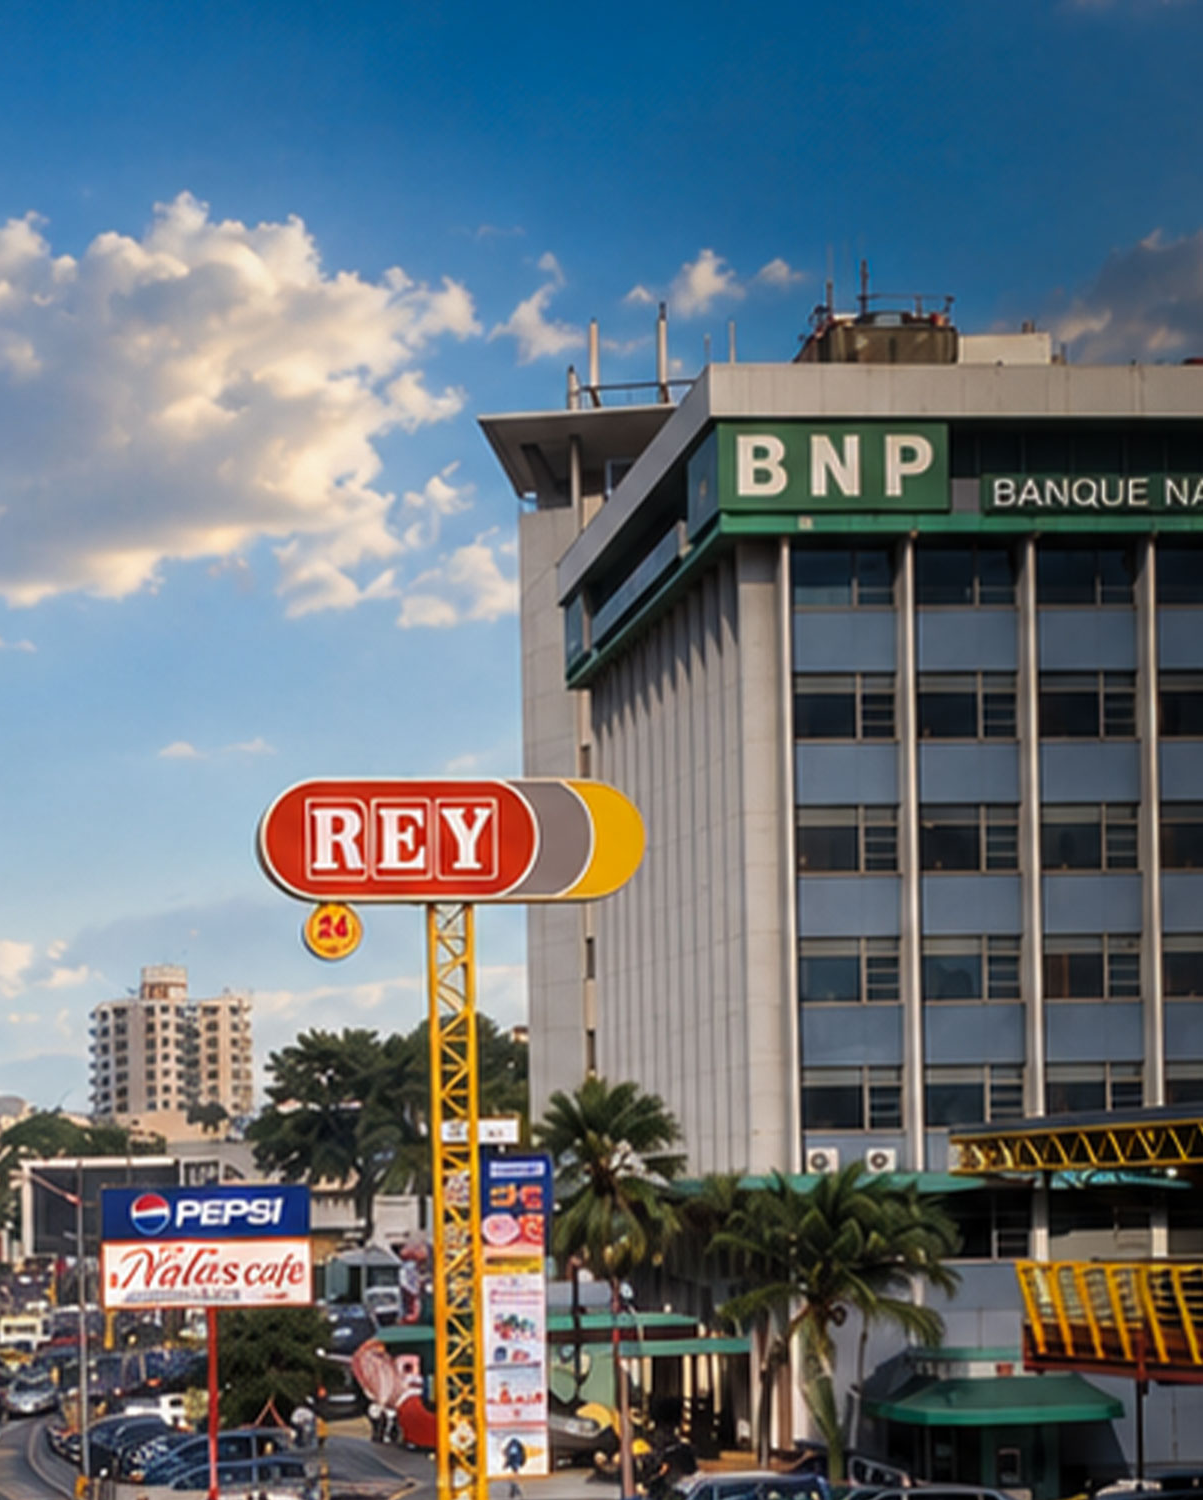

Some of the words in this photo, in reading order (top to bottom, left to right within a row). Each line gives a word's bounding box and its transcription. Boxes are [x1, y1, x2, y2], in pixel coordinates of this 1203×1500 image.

[735, 433, 936, 498] BNP
[993, 477, 1150, 509] BANQUE
[310, 807, 494, 872] REY
[175, 1198, 284, 1228] PEPSI
